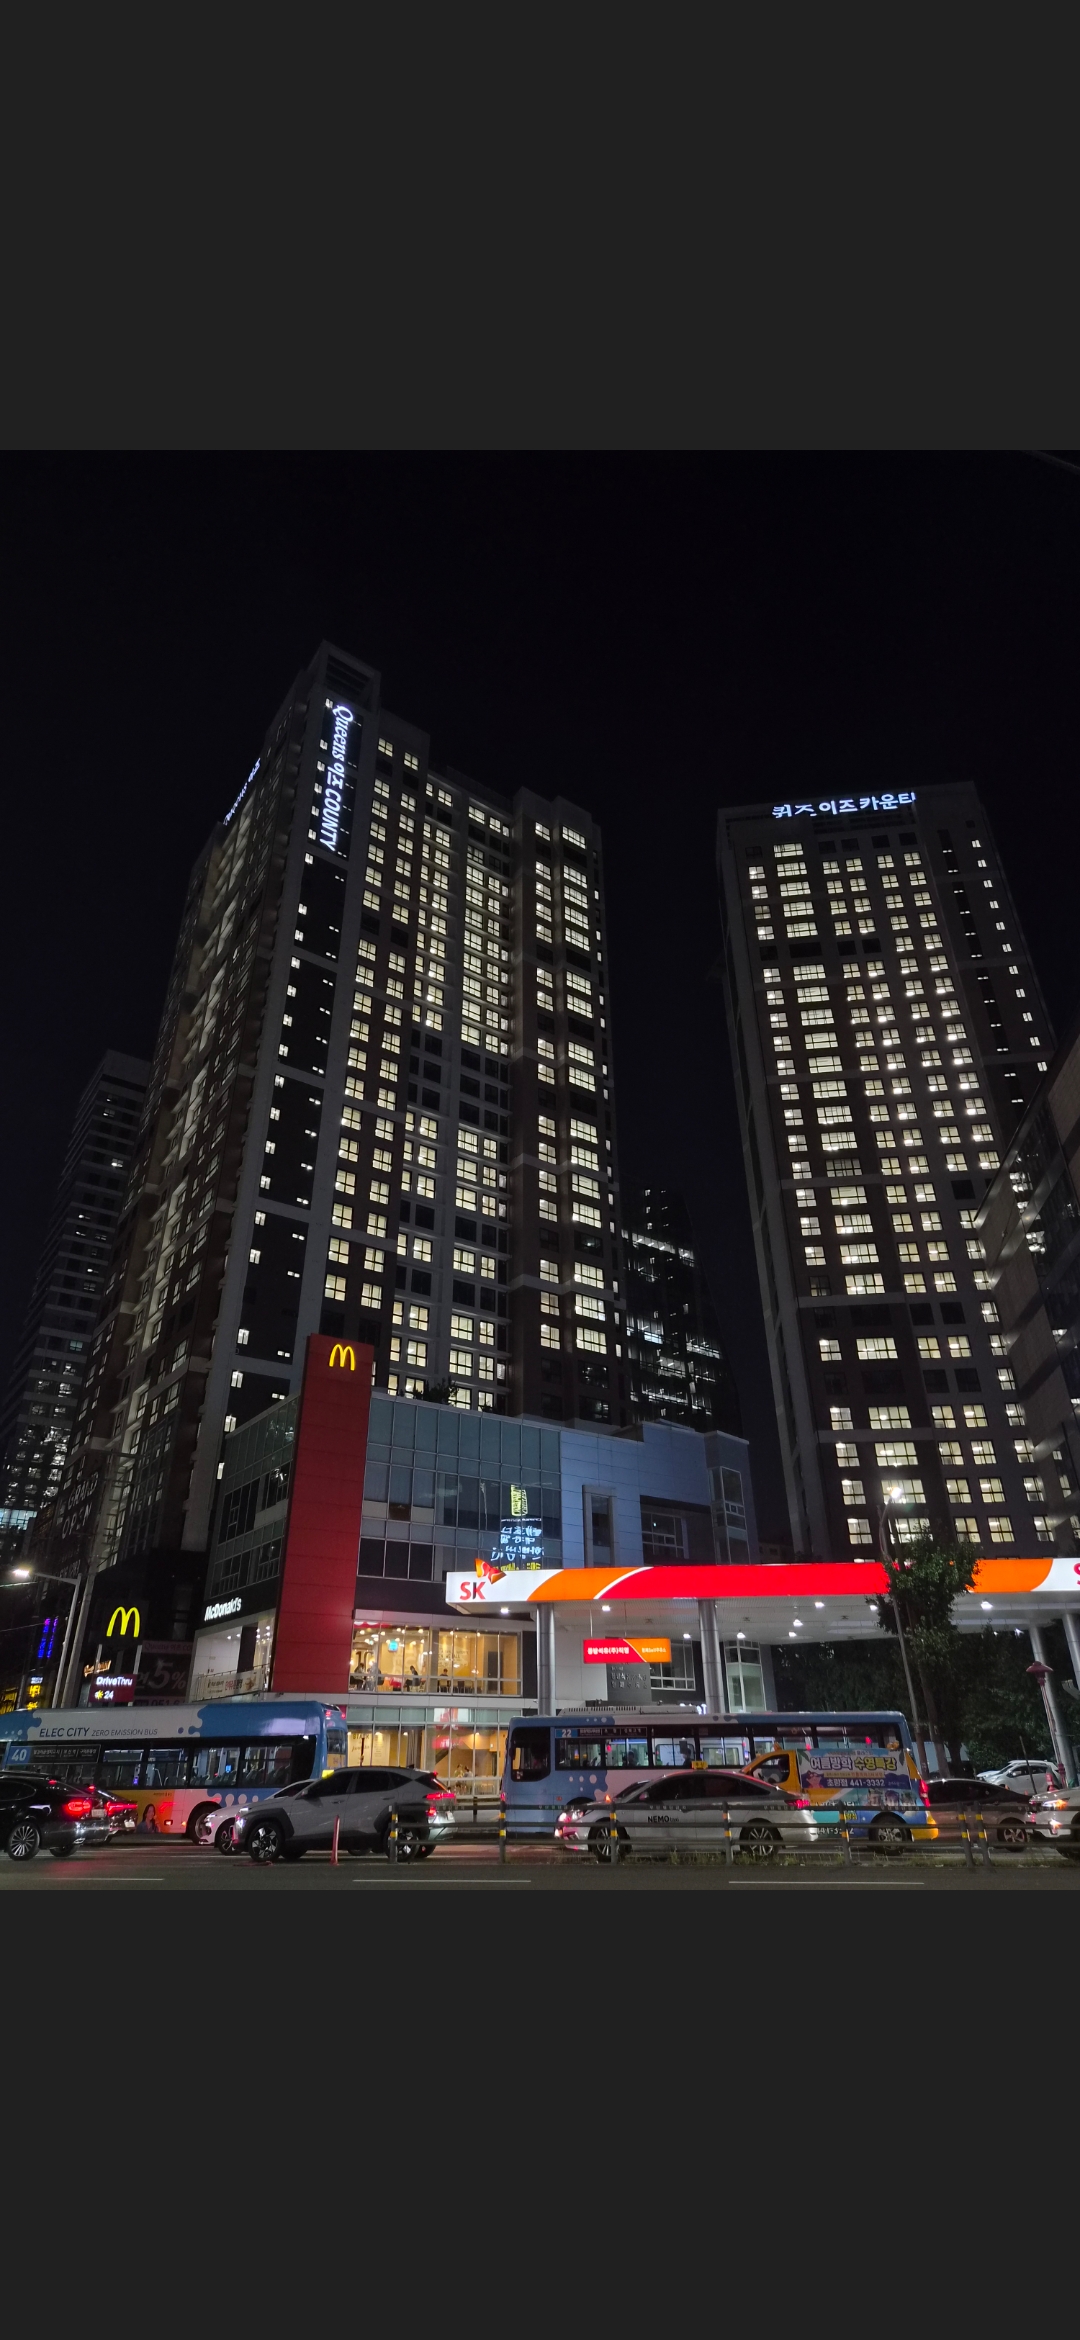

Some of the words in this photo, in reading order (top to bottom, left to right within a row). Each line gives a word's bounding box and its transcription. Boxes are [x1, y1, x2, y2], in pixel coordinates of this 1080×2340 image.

[332, 705, 354, 761] Queens
[319, 789, 342, 852] COUNTY
[459, 1581, 486, 1601] SK
[204, 1597, 243, 1622] McDonald's
[96, 1676, 133, 1687] DriveThru
[104, 1690, 114, 1700] 24
[39, 1728, 64, 1738] ELEC
[67, 1727, 90, 1737] CITY
[91, 1729, 110, 1737] ZERO
[111, 1728, 144, 1737] EMISSION
[145, 1728, 158, 1736] BUS
[561, 1729, 572, 1738] 22
[11, 1749, 27, 1761] 40
[810, 1757, 853, 1770] 여름방학
[854, 1757, 897, 1770] 수영특강
[849, 1778, 886, 1787] 441-3332
[648, 1815, 669, 1823] NEMO
